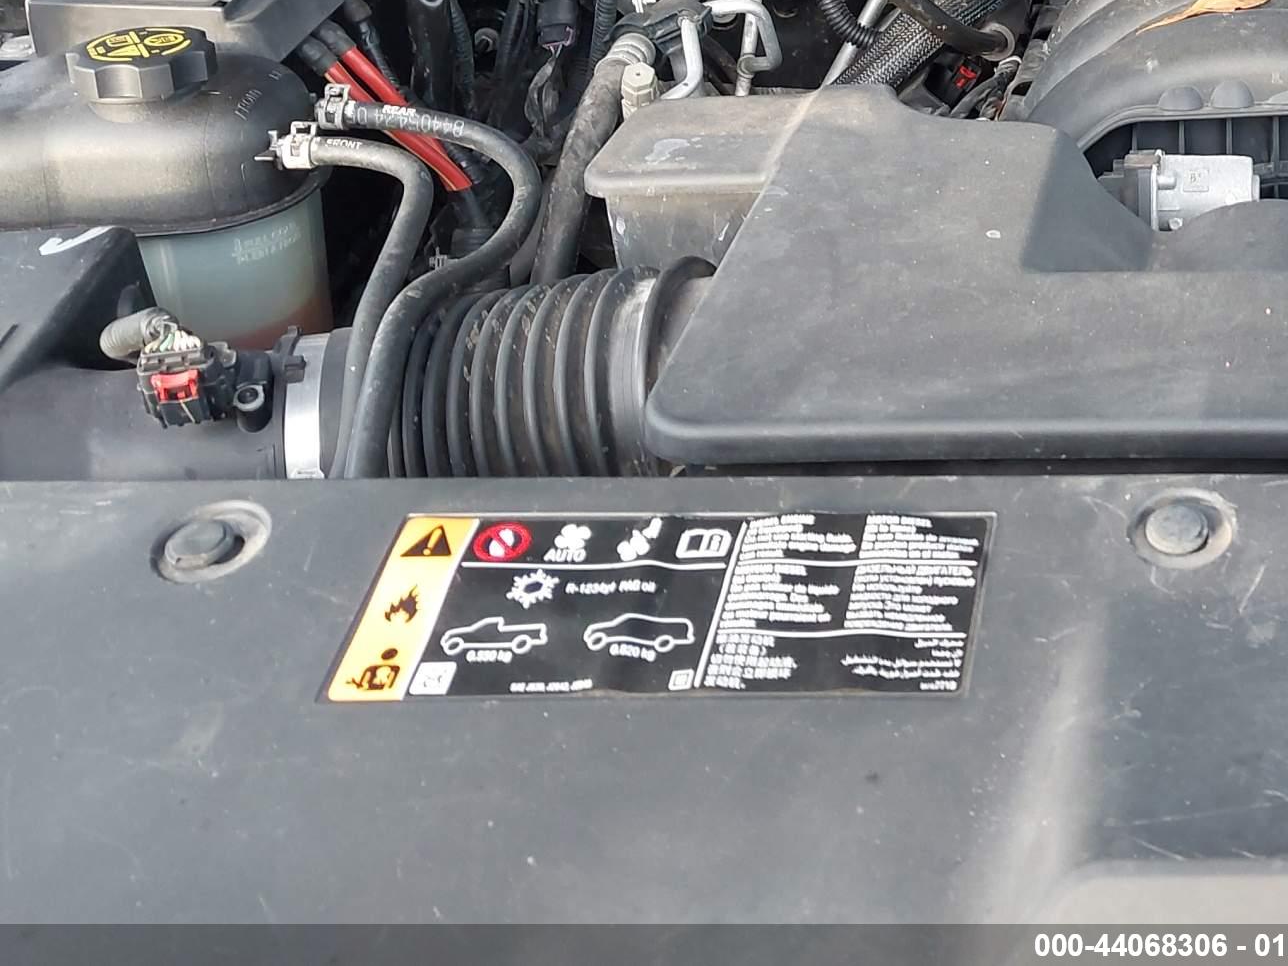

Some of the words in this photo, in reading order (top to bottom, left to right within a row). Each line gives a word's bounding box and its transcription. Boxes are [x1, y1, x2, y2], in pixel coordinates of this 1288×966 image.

[382, 104, 417, 116] REAR
[325, 138, 363, 150] FRONT
[543, 548, 587, 563] AUTO
